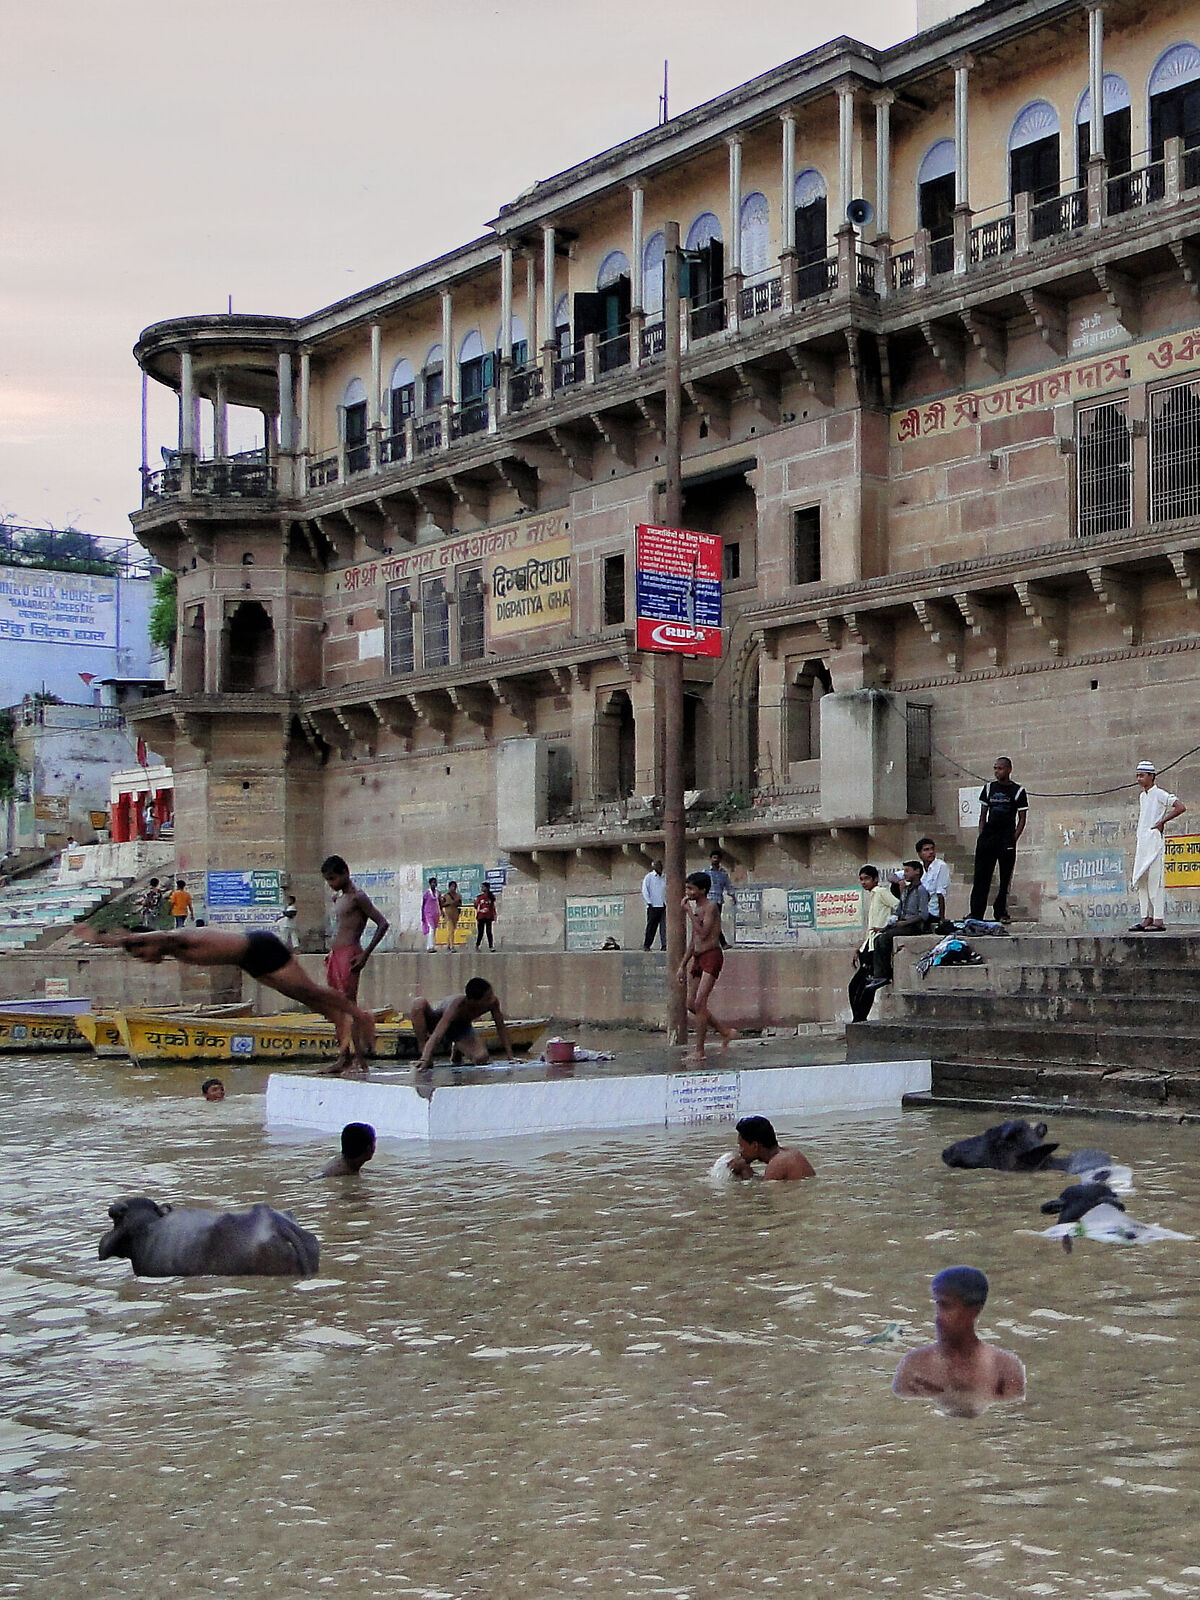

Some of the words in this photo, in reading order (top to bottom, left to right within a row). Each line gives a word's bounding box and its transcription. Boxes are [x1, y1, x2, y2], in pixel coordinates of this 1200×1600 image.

[61, 588, 96, 602] HOUSE
[497, 595, 543, 621] DIGPATIYA
[665, 626, 706, 640] RUPA
[1060, 858, 1104, 881] Vishnu
[254, 878, 279, 888] YOGA
[737, 893, 760, 902] GANGA
[568, 905, 598, 918] BREAD
[604, 904, 624, 917] LIFE
[788, 902, 811, 912] YOGA
[260, 1037, 293, 1050] UCO
